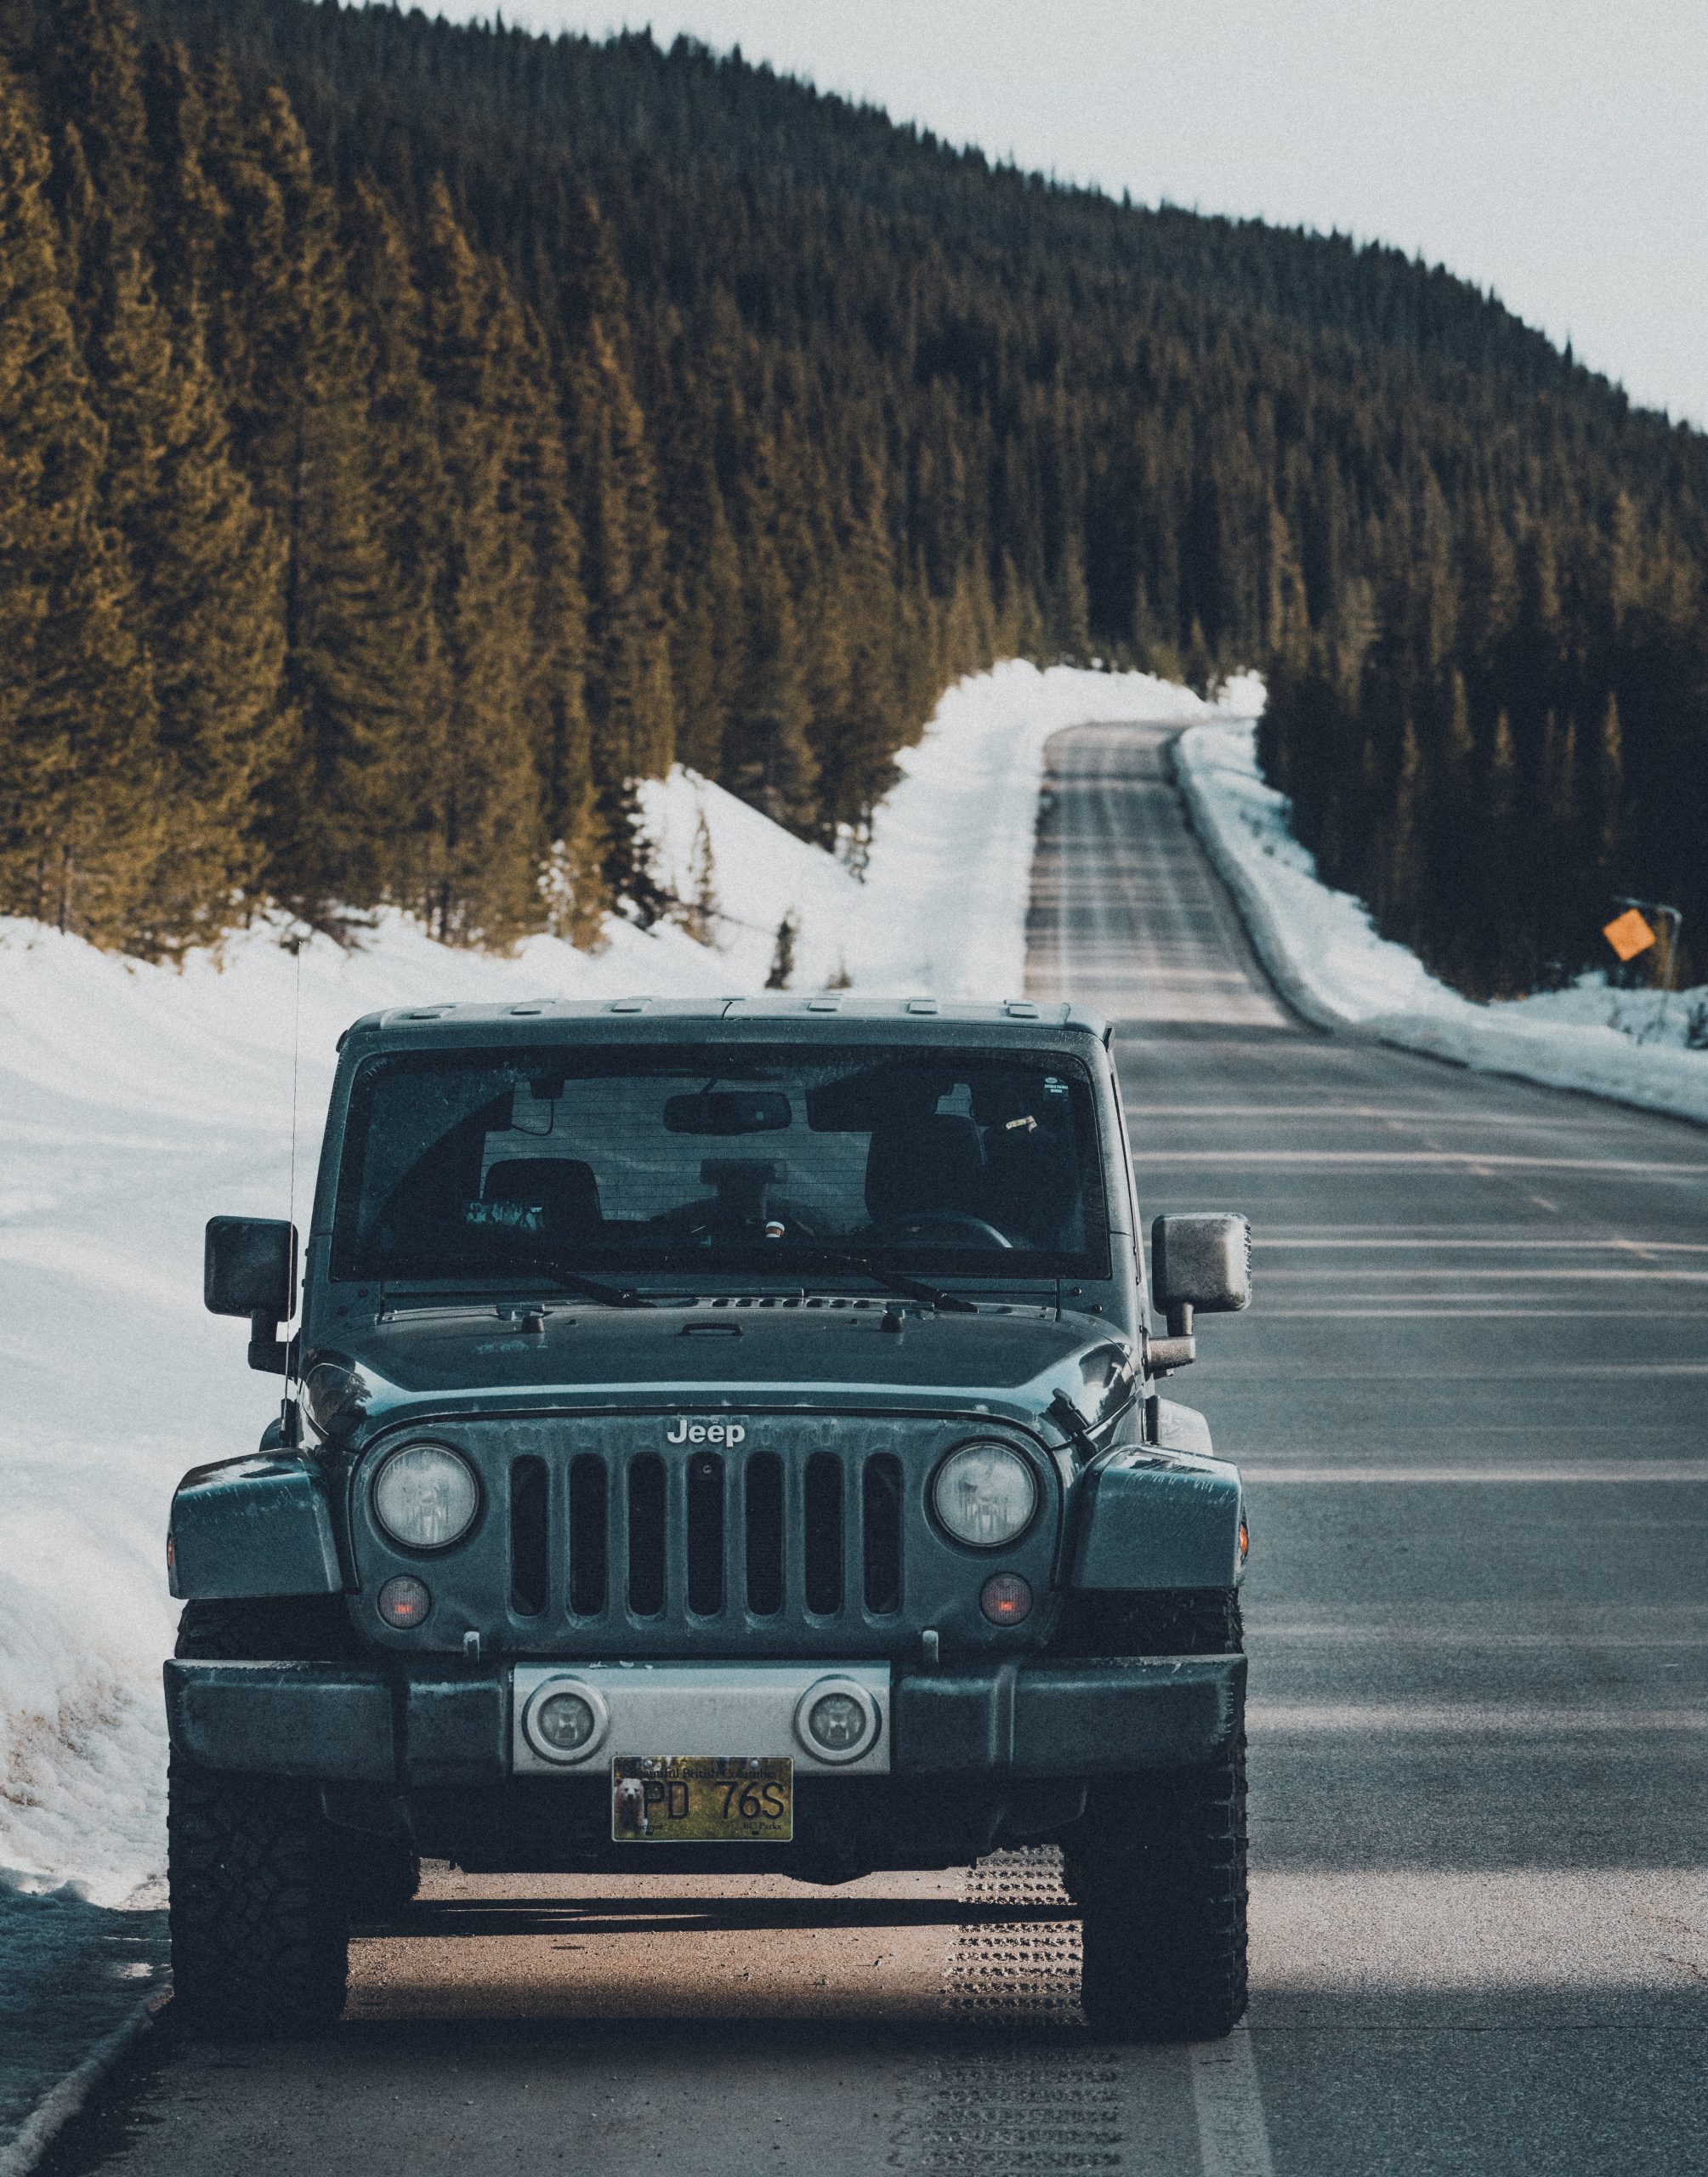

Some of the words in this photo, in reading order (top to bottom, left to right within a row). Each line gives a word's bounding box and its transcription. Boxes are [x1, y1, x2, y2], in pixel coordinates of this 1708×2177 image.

[667, 1419, 746, 1447] Jeep
[683, 1768, 718, 1778] British
[644, 1781, 689, 1819] PD
[716, 1781, 785, 1820] 76S
